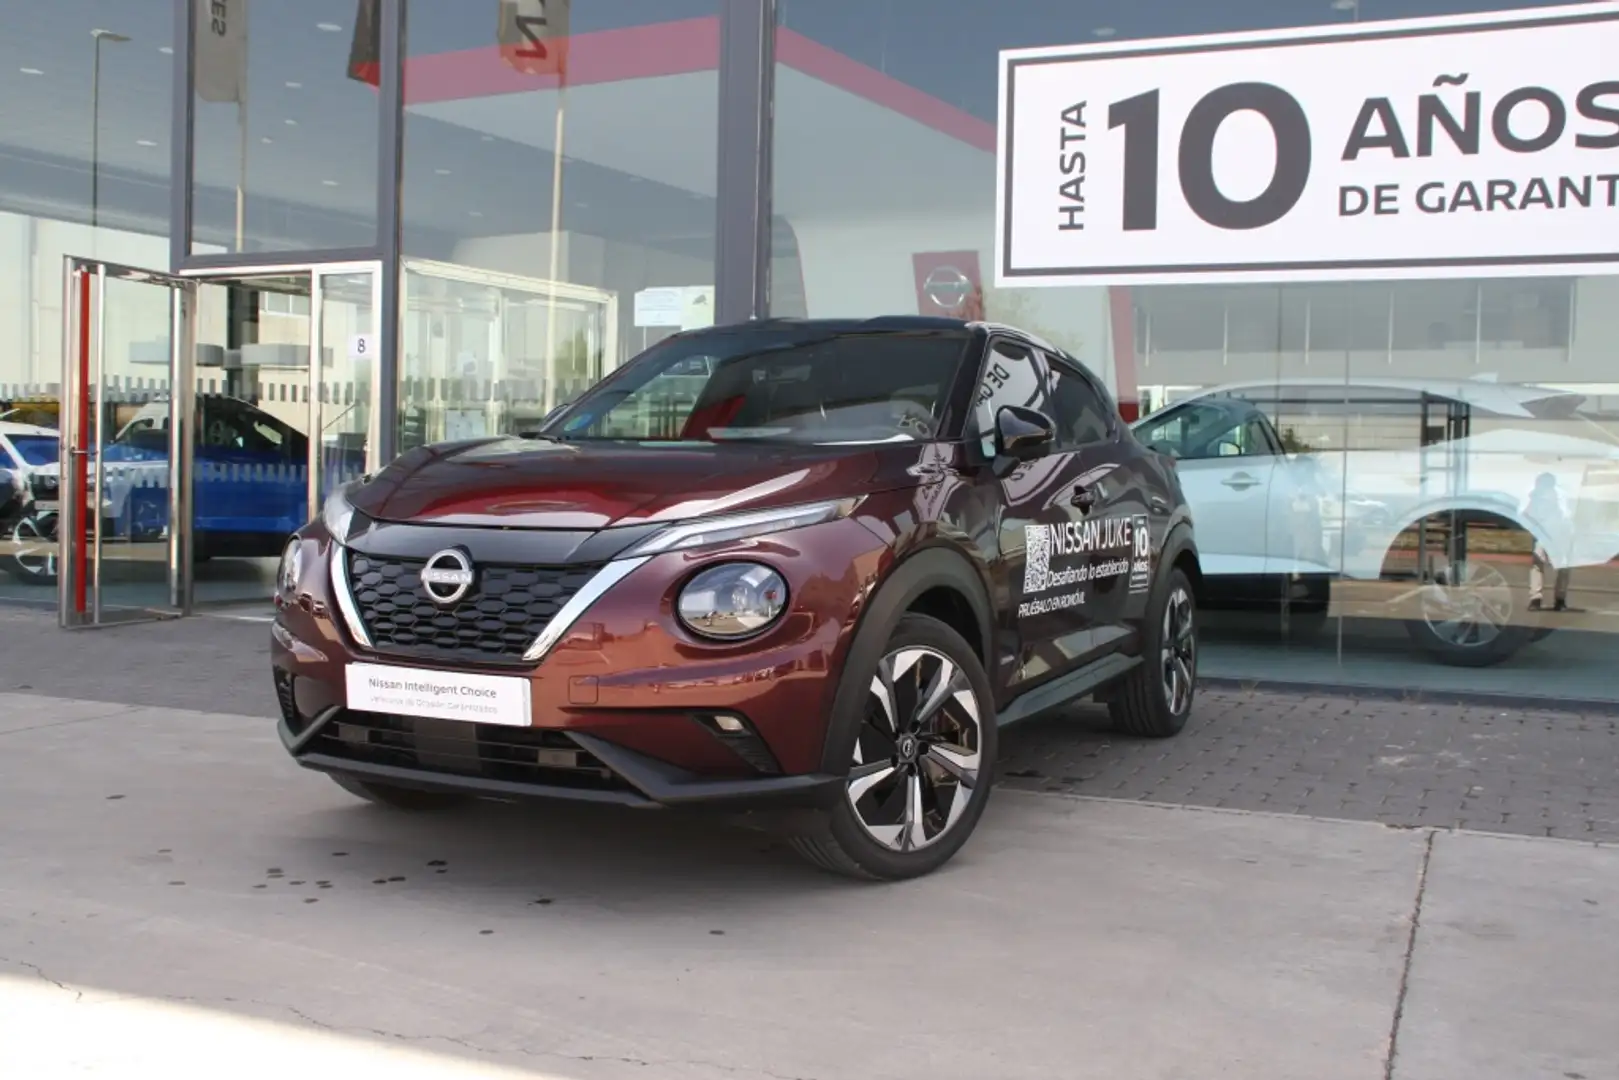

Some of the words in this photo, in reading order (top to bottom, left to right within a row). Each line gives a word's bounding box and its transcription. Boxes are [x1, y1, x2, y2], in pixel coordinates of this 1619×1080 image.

[1341, 72, 1619, 161] AÑOS
[1058, 100, 1087, 231] HASTA
[1107, 81, 1312, 232] 10
[1338, 184, 1400, 216] DE
[1415, 174, 1619, 214] GARANT
[357, 338, 366, 353] 8
[1051, 520, 1101, 555] NISSAN
[1102, 517, 1131, 549] JUKE
[1135, 527, 1148, 557] 10
[1047, 565, 1088, 587] Desafiando
[1088, 563, 1096, 580] lo
[1096, 558, 1129, 578] establecido
[369, 678, 402, 690] Nissan
[405, 681, 457, 695] Intelligent
[460, 686, 497, 698] Choice
